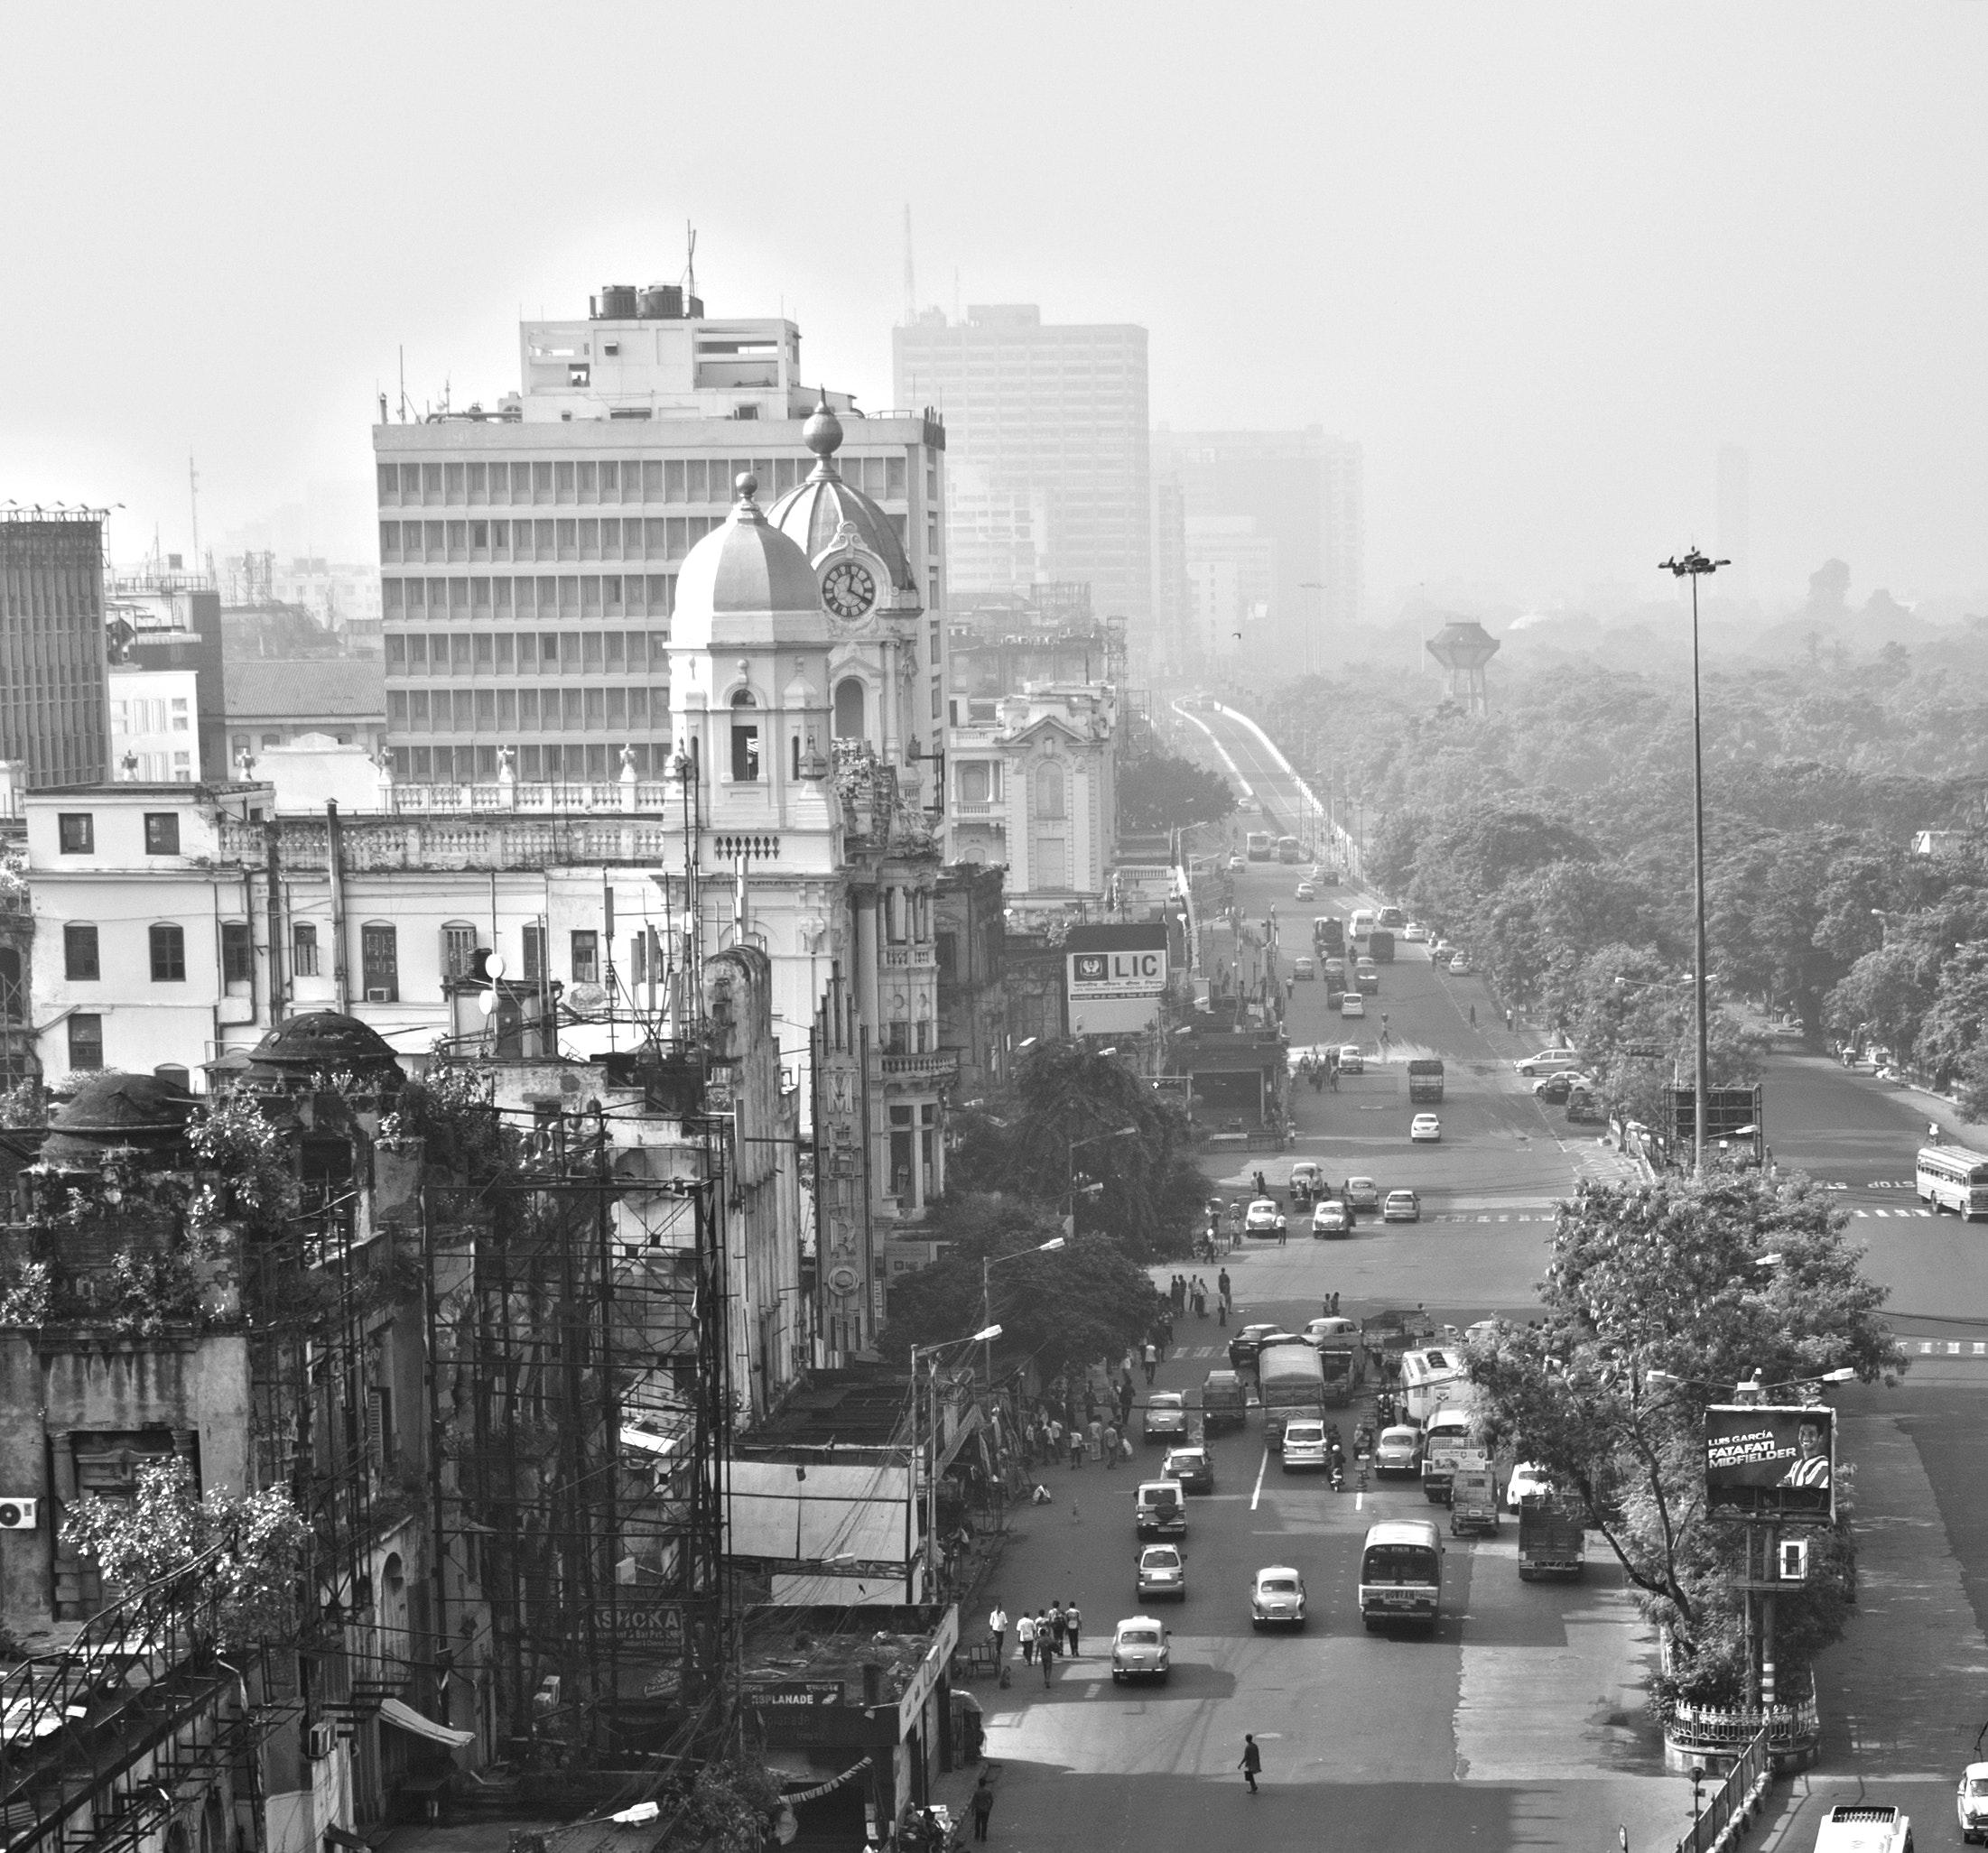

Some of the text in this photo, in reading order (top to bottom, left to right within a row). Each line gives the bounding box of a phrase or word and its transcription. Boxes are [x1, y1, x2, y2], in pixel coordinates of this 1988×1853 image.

[1115, 955, 1157, 977] LIC
[1867, 1181, 1916, 1189] STOP
[1708, 1437, 1730, 1446] LUIS
[1708, 1441, 1775, 1459] FATAFATI
[1708, 1447, 1797, 1469] MIDFIELDER
